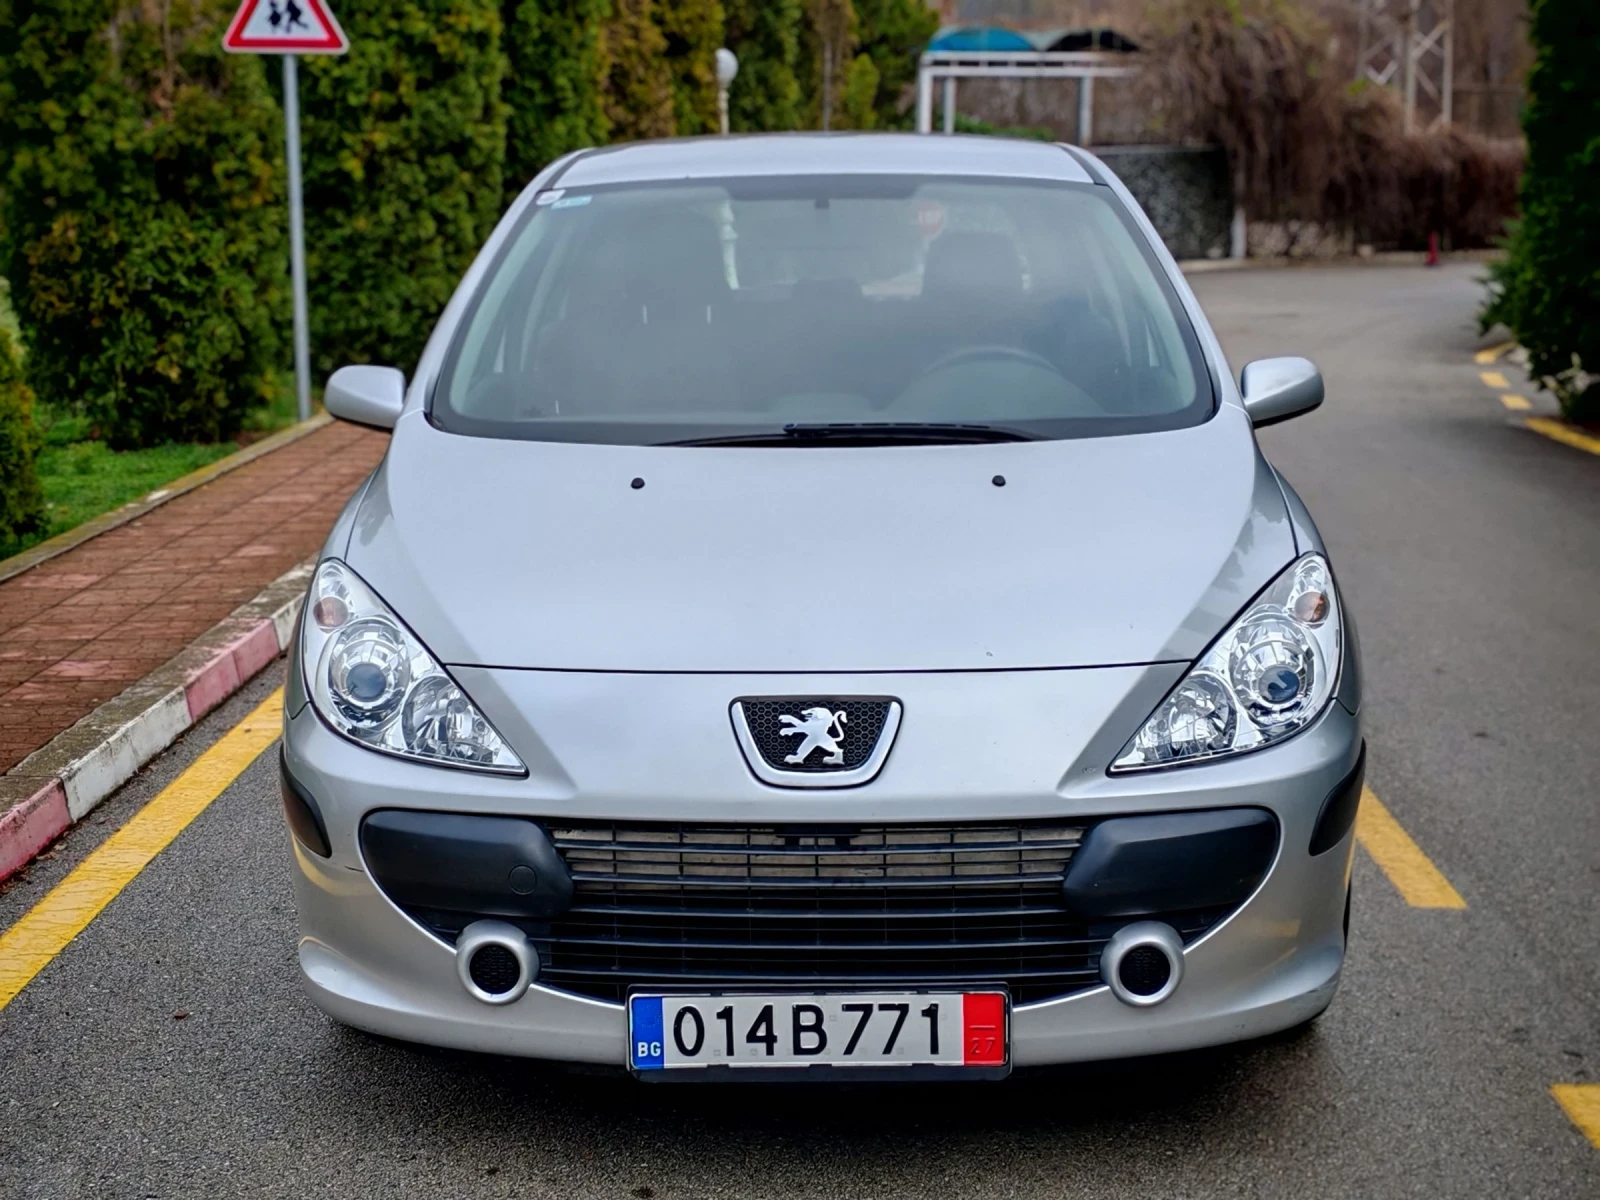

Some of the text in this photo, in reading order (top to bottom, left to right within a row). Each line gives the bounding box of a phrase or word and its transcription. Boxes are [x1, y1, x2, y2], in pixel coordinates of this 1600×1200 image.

[674, 1003, 939, 1056] 014B771
[637, 1041, 661, 1058] BG
[971, 1037, 996, 1054] 27
